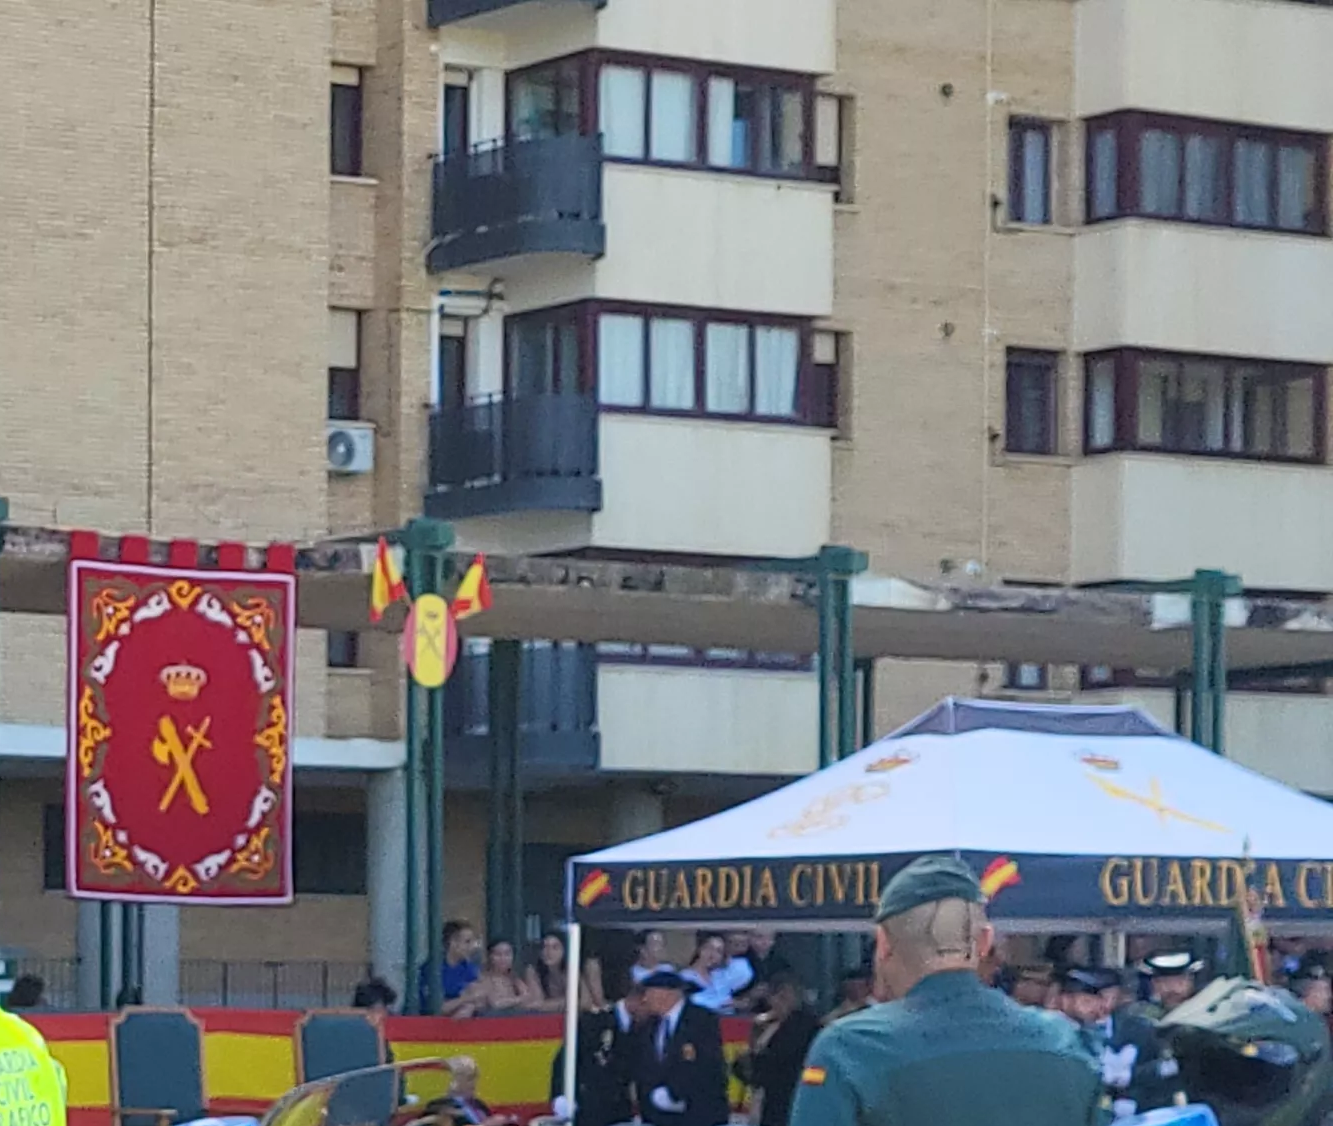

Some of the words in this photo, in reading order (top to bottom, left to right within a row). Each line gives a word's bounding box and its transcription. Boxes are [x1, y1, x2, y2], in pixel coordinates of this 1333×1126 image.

[622, 864, 778, 911] GUARDIA
[789, 861, 881, 907] CIVIL
[1099, 856, 1285, 908] GUARDA
